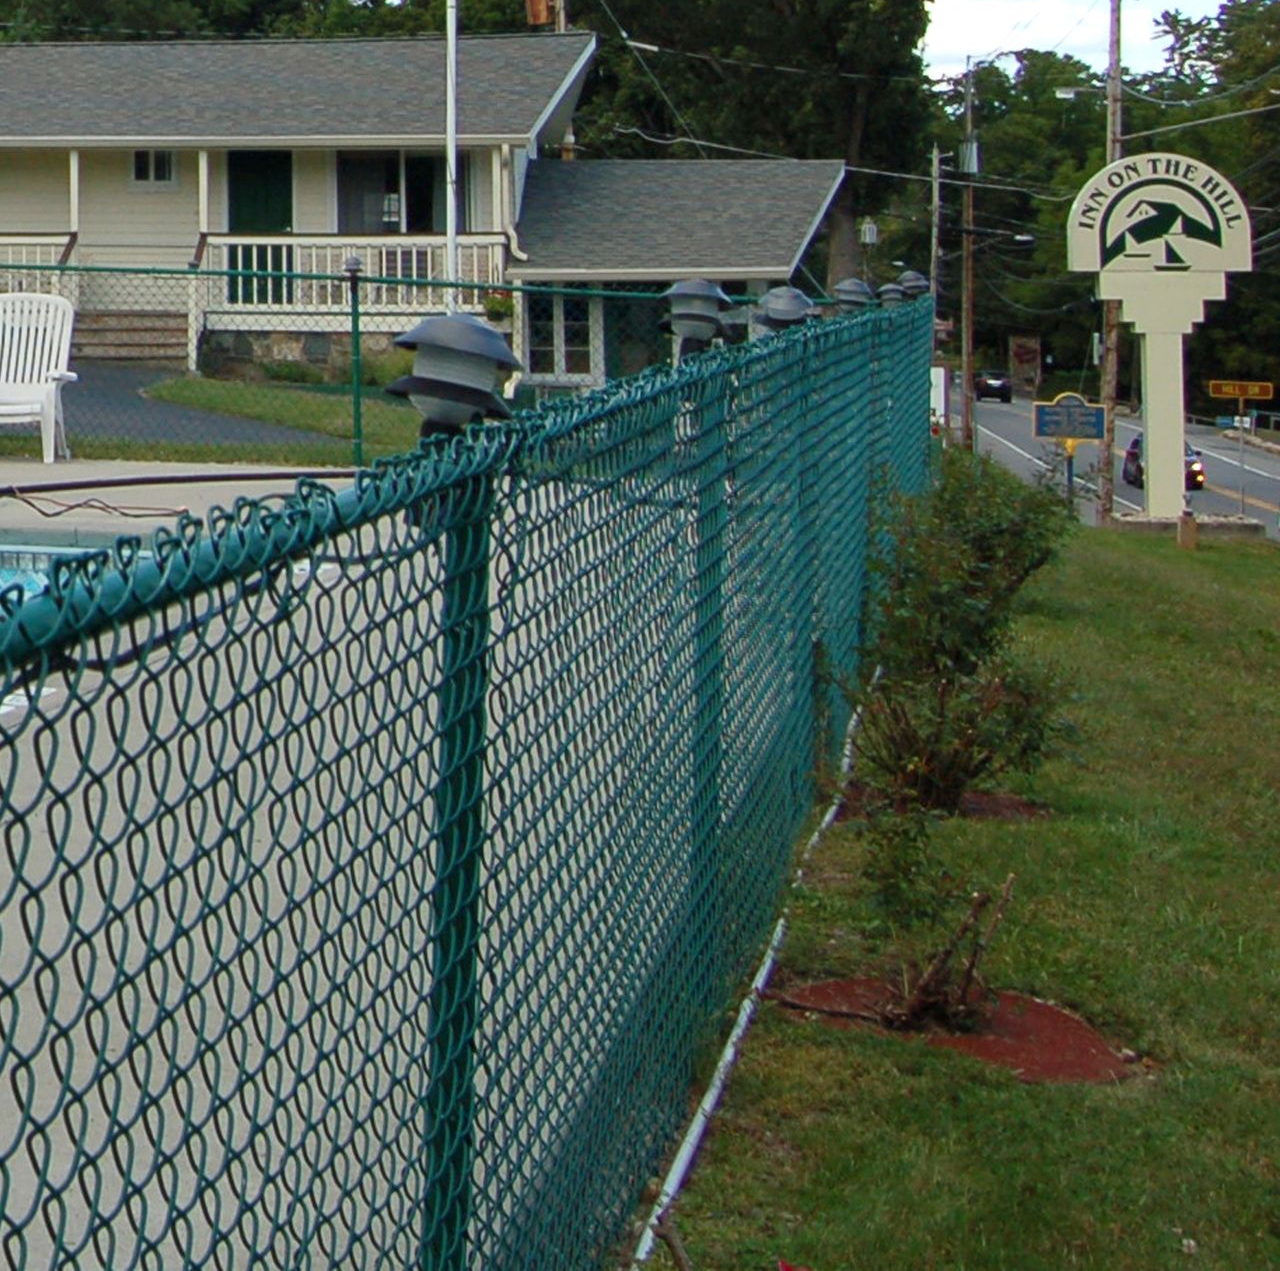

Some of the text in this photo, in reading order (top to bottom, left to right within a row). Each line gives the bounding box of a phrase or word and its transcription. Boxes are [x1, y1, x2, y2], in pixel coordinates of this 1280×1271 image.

[1078, 158, 1242, 230] INN ON THE HILL
